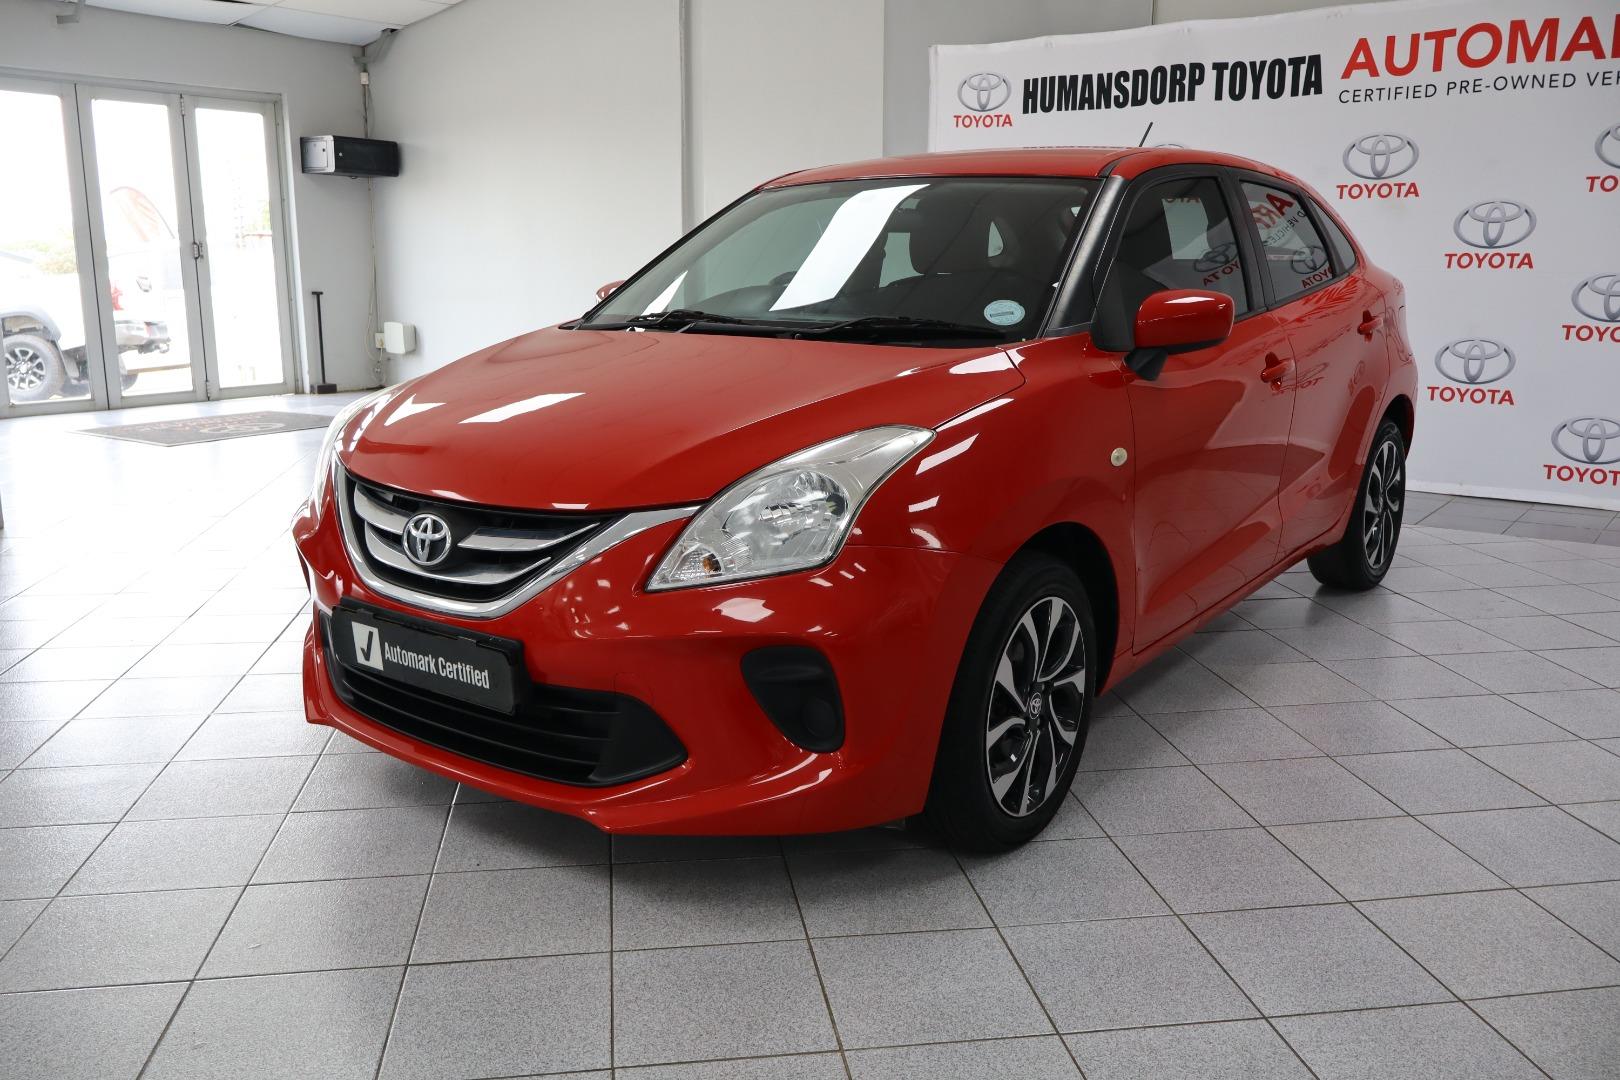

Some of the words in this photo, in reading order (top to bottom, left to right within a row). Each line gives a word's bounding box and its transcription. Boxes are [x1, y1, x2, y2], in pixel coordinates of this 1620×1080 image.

[1340, 13, 1620, 81] AUTOMA
[1022, 62, 1206, 115] HUMANSDORP
[1211, 53, 1323, 101] TOYOTA
[1338, 83, 1438, 104] CERTIFIED
[1446, 72, 1577, 96] PRE-OWNED
[1586, 70, 1620, 87] VE
[953, 113, 1013, 129] TOYOTA
[1336, 181, 1420, 201] TOYOTA
[1444, 252, 1535, 270] TOYOTA
[1427, 385, 1515, 406] TOYOTA
[384, 641, 437, 675] Automark
[438, 656, 490, 690] Certified
